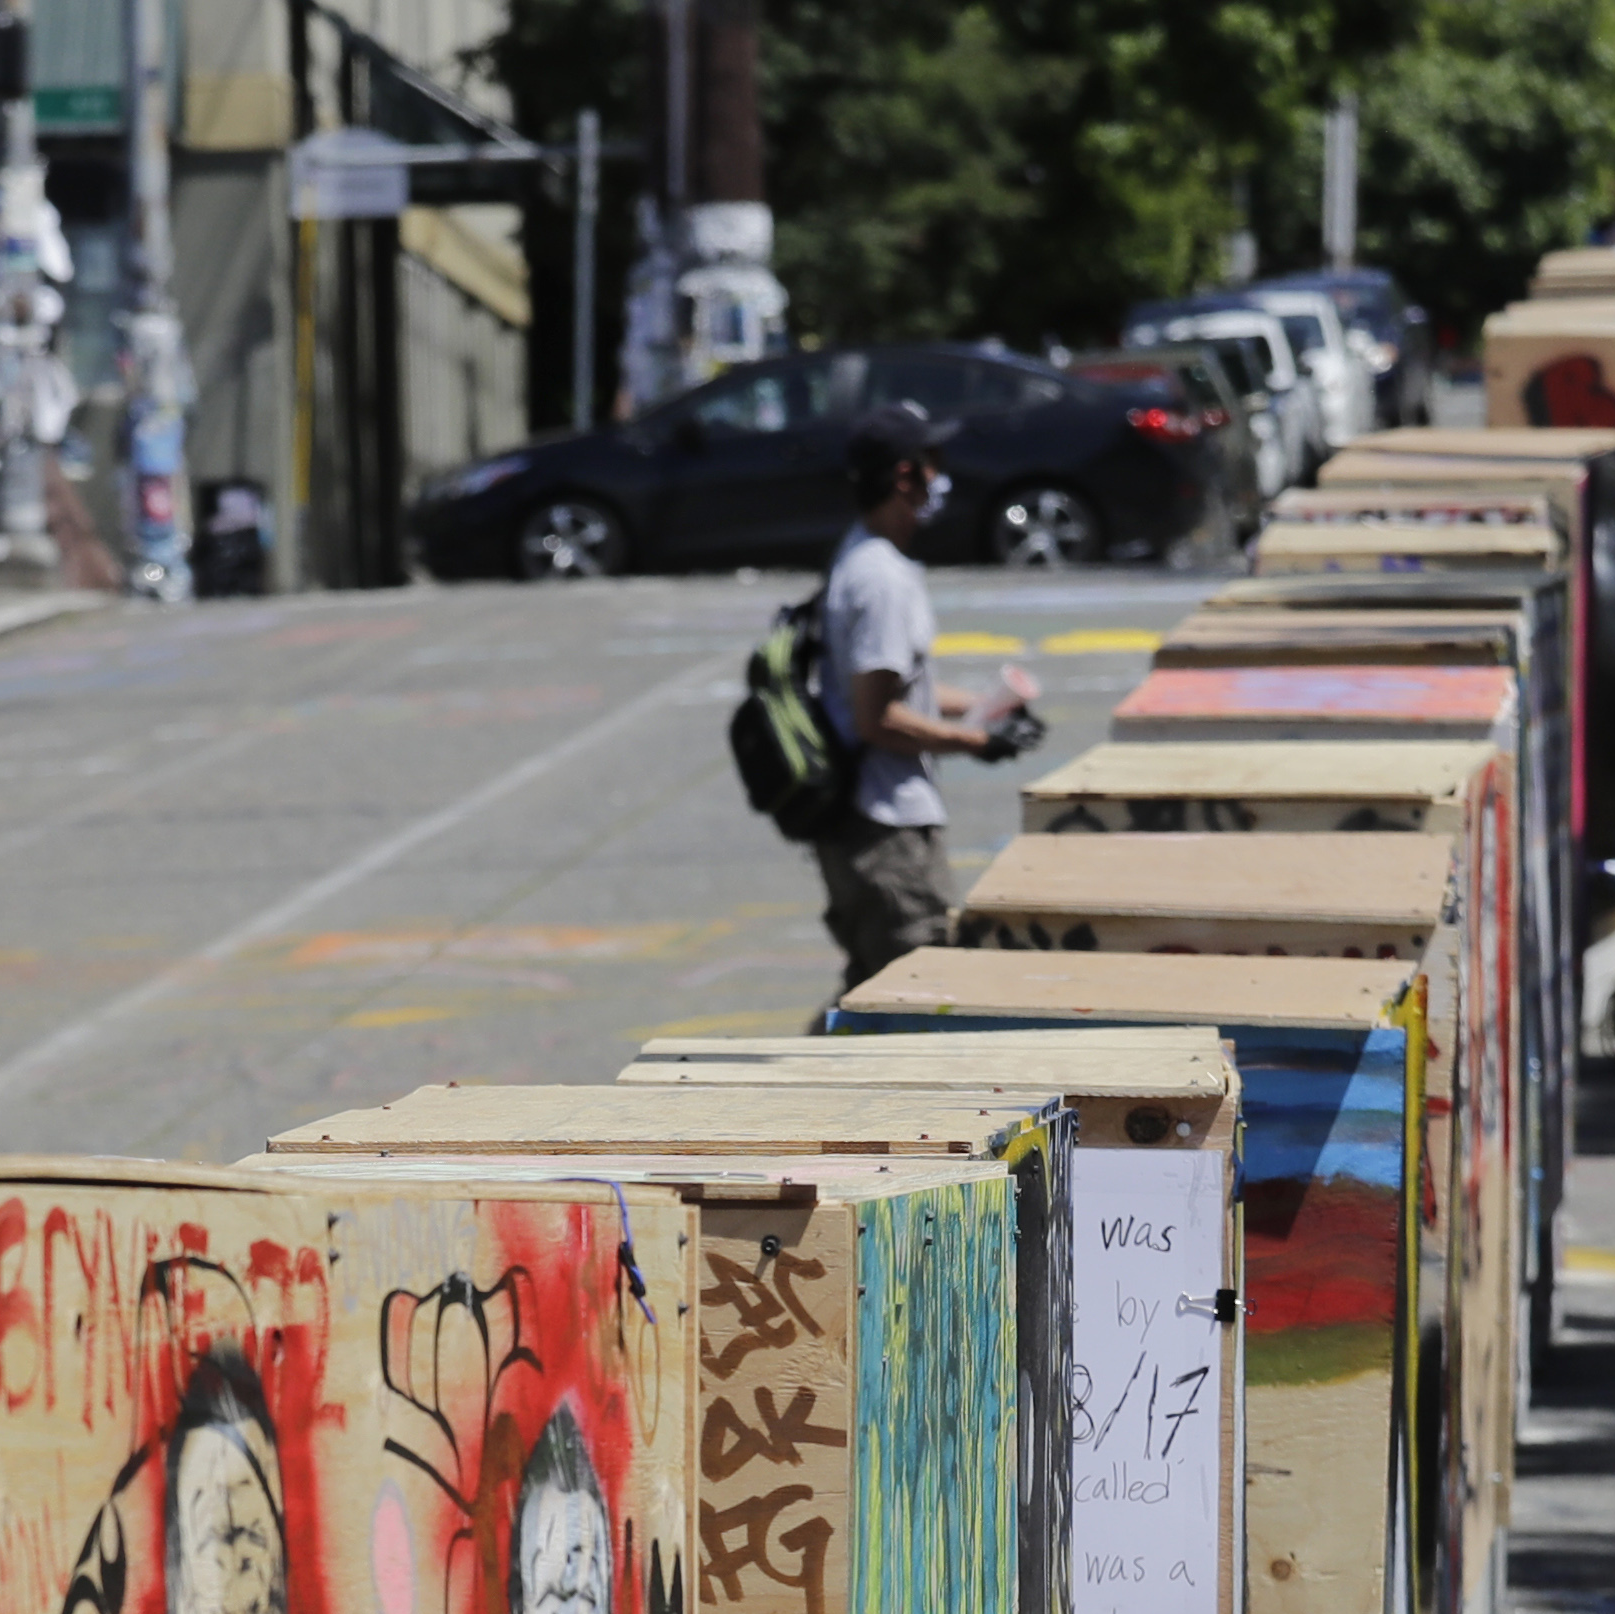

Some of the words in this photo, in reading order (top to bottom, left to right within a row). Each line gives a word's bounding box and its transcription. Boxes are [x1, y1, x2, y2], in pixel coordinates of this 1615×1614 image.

[1101, 1214, 1178, 1252] was
[1116, 1279, 1161, 1344] by
[1085, 1551, 1146, 1586] was
[1169, 1560, 1195, 1587] a
